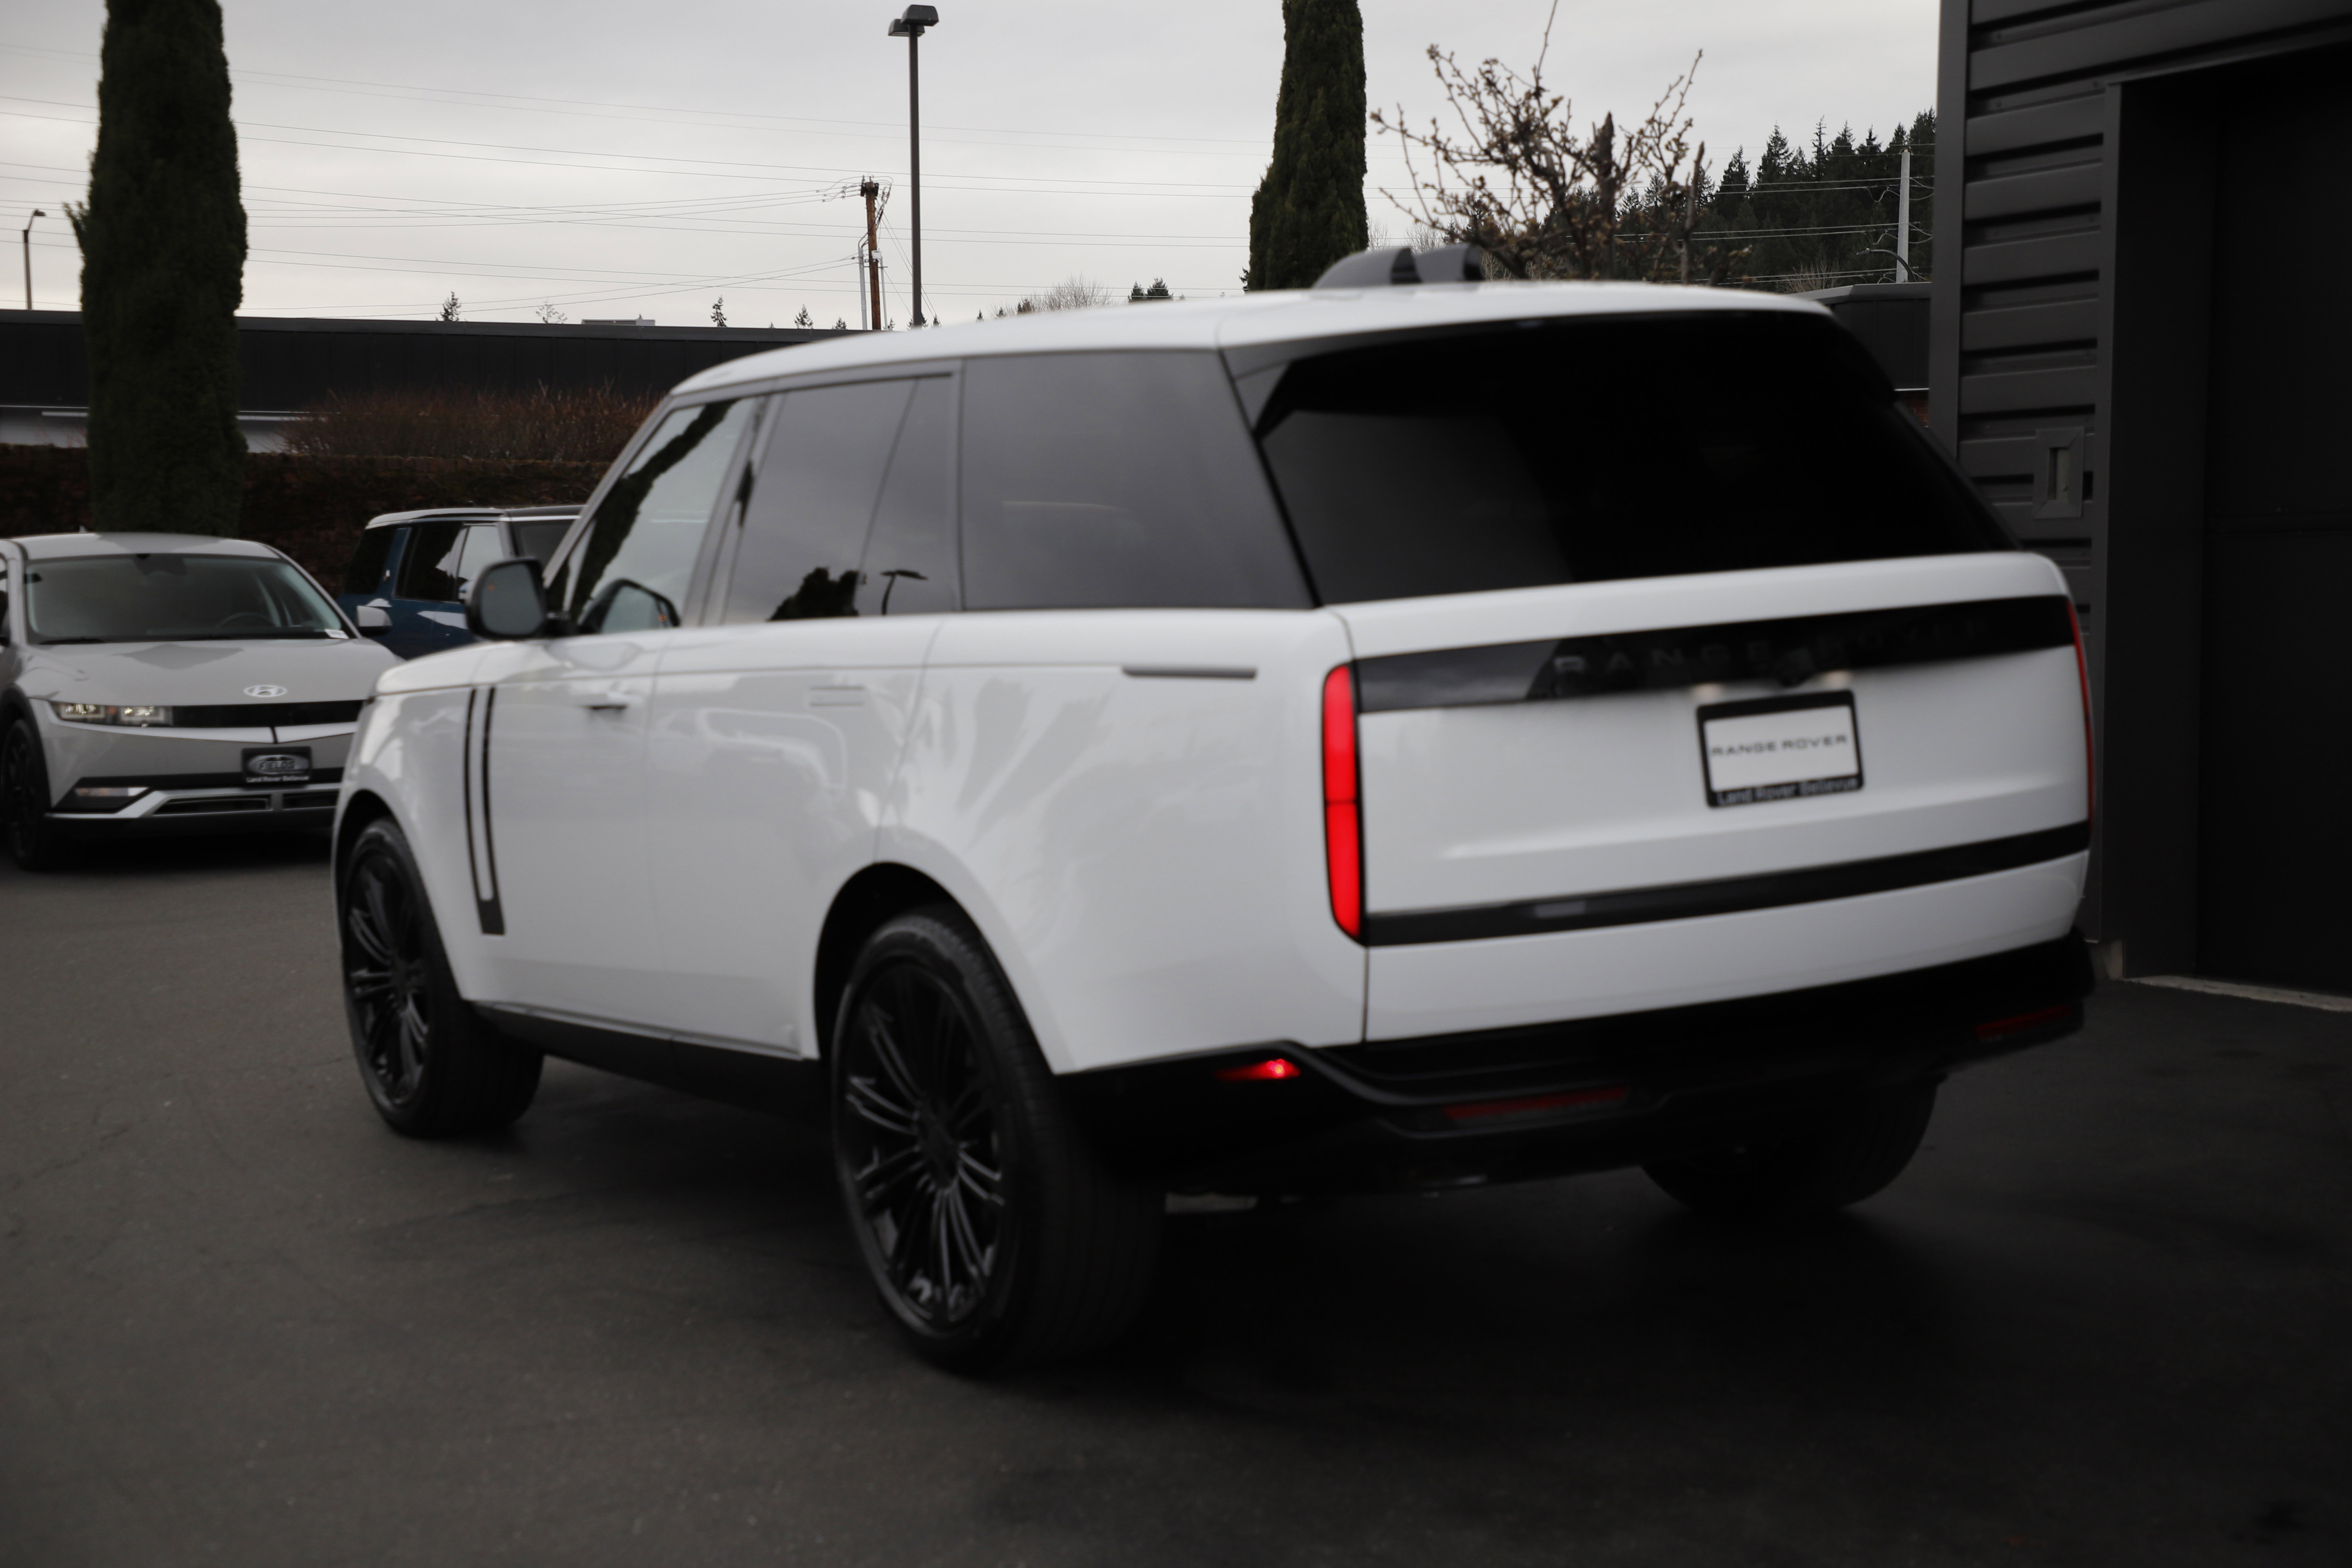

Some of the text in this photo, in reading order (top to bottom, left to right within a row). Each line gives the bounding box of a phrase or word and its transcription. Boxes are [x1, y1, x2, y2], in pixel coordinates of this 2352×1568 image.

[1554, 640, 1771, 674] RANGE
[1711, 735, 1847, 756] RANGE ROVER
[1717, 777, 1857, 805] Land Rover Bellevue
